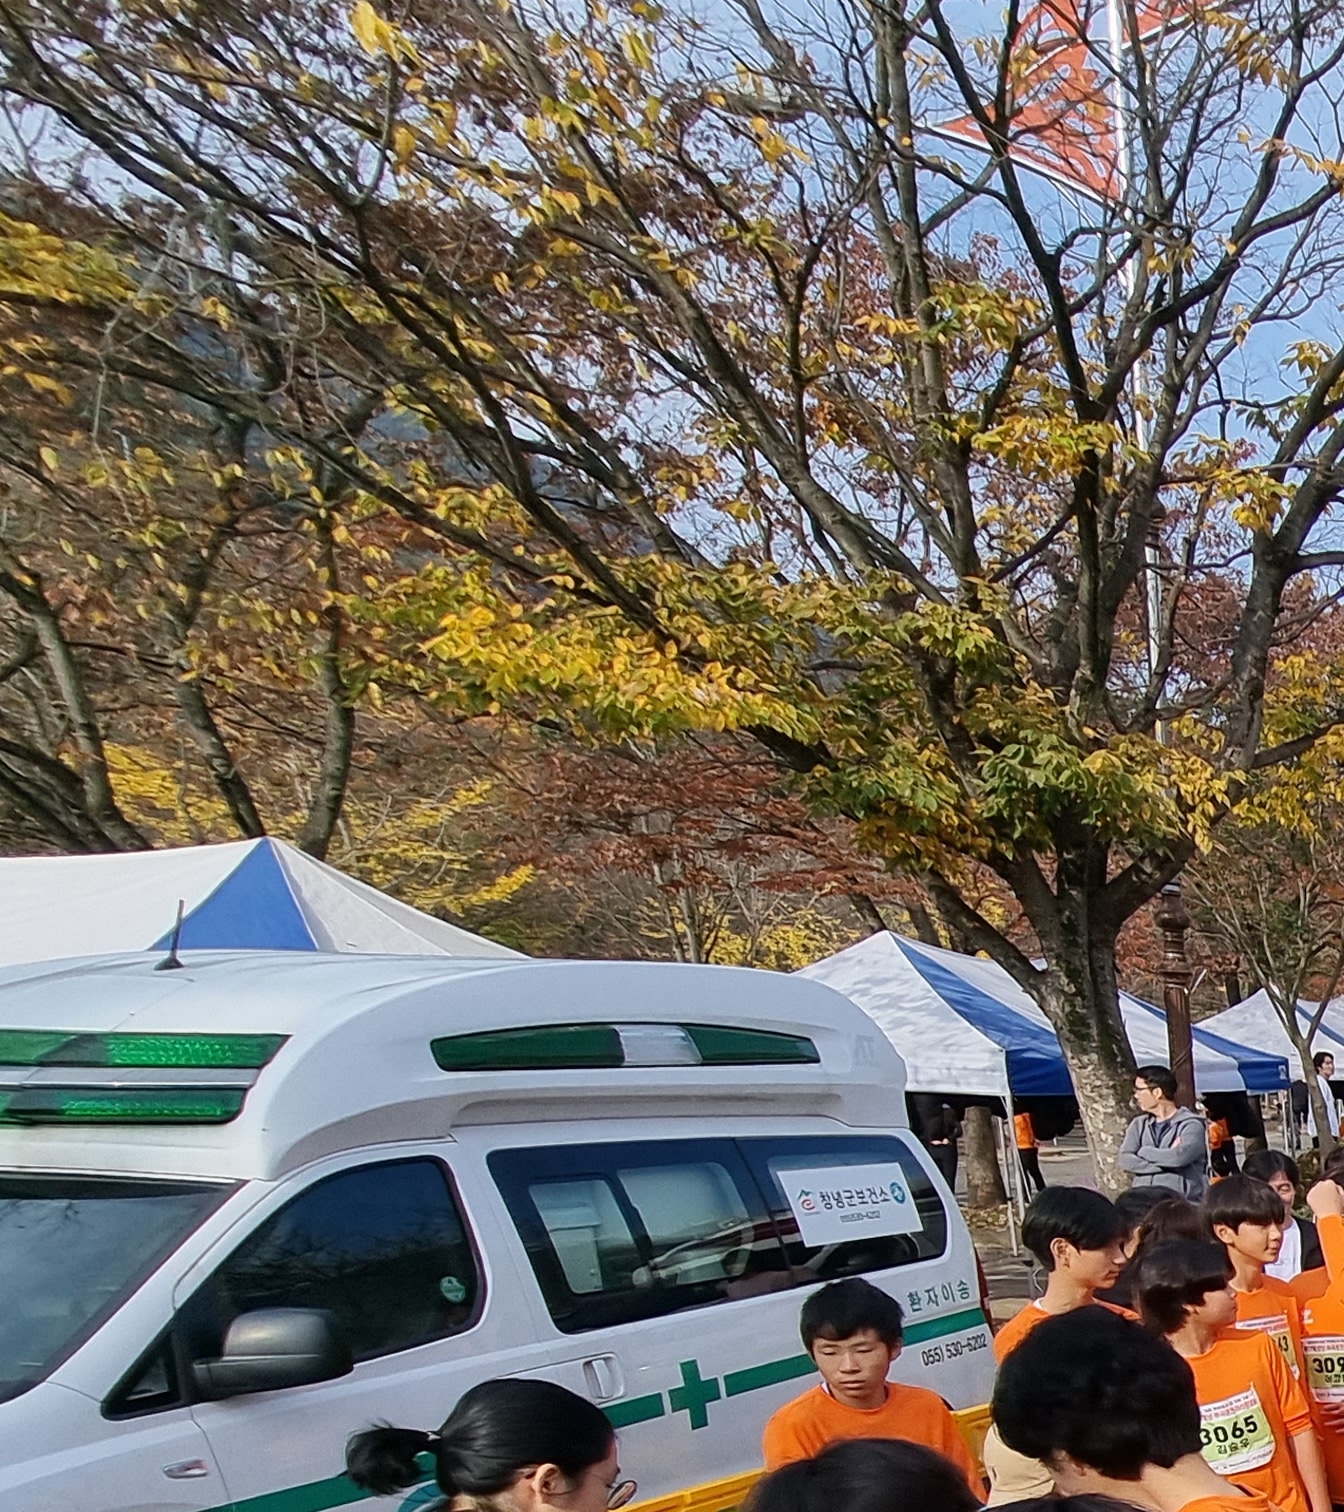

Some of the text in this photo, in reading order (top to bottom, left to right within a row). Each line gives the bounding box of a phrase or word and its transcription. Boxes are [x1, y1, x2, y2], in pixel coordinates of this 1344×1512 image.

[819, 1186, 890, 1210] 창녕군보건소
[907, 1280, 970, 1312] 환자이송
[1200, 1415, 1258, 1446] 3065
